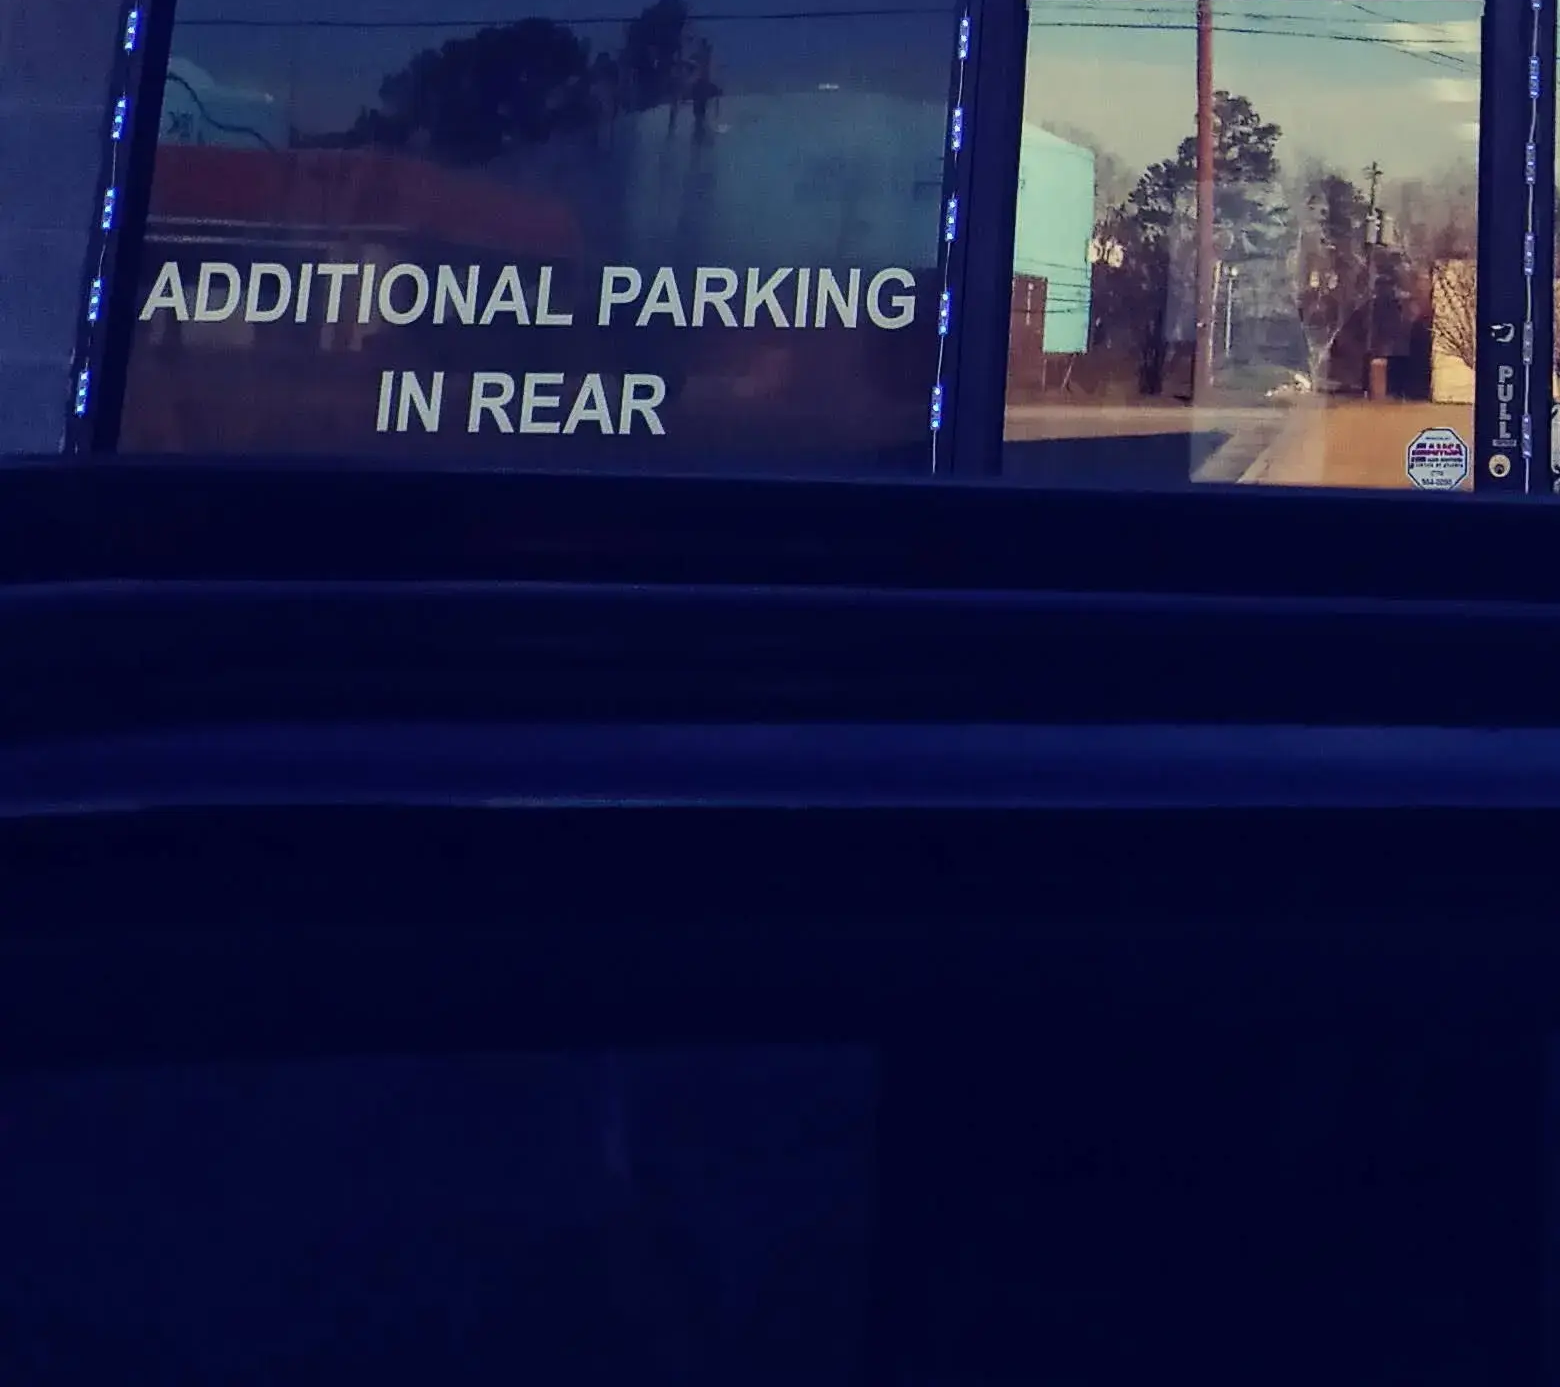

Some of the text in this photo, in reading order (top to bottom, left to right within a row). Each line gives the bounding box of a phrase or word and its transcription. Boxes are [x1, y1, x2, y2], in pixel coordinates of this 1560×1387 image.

[139, 262, 918, 330] ADDITIONAL PARKING
[376, 372, 667, 435] IN REAR
[1498, 365, 1514, 439] PULL
